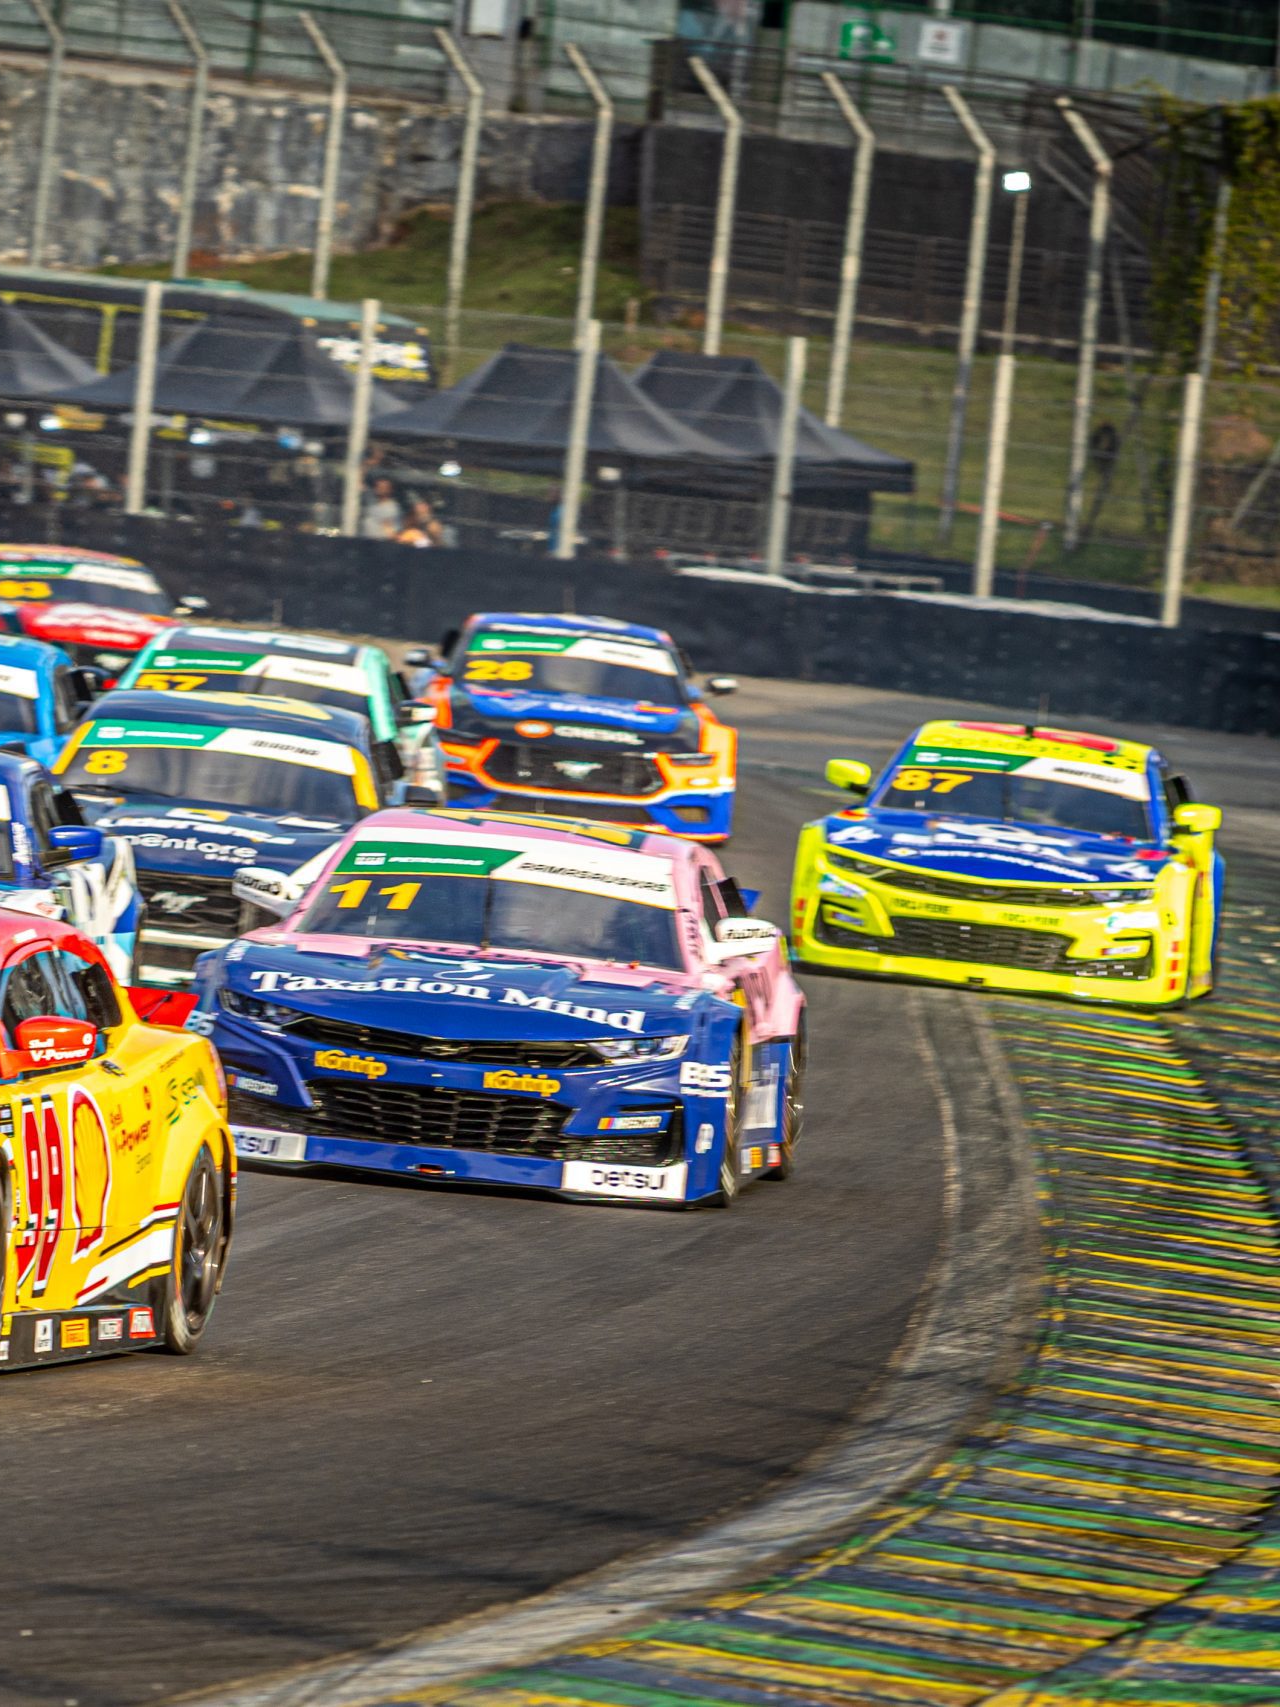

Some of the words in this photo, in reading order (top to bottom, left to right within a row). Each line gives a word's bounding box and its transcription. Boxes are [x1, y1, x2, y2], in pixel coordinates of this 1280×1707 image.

[464, 660, 533, 681] 28
[133, 674, 208, 691] 57
[84, 750, 129, 774] 8
[891, 770, 973, 793] 87
[328, 880, 422, 910] 11
[250, 970, 492, 1000] Taxation
[497, 987, 645, 1034] Mind
